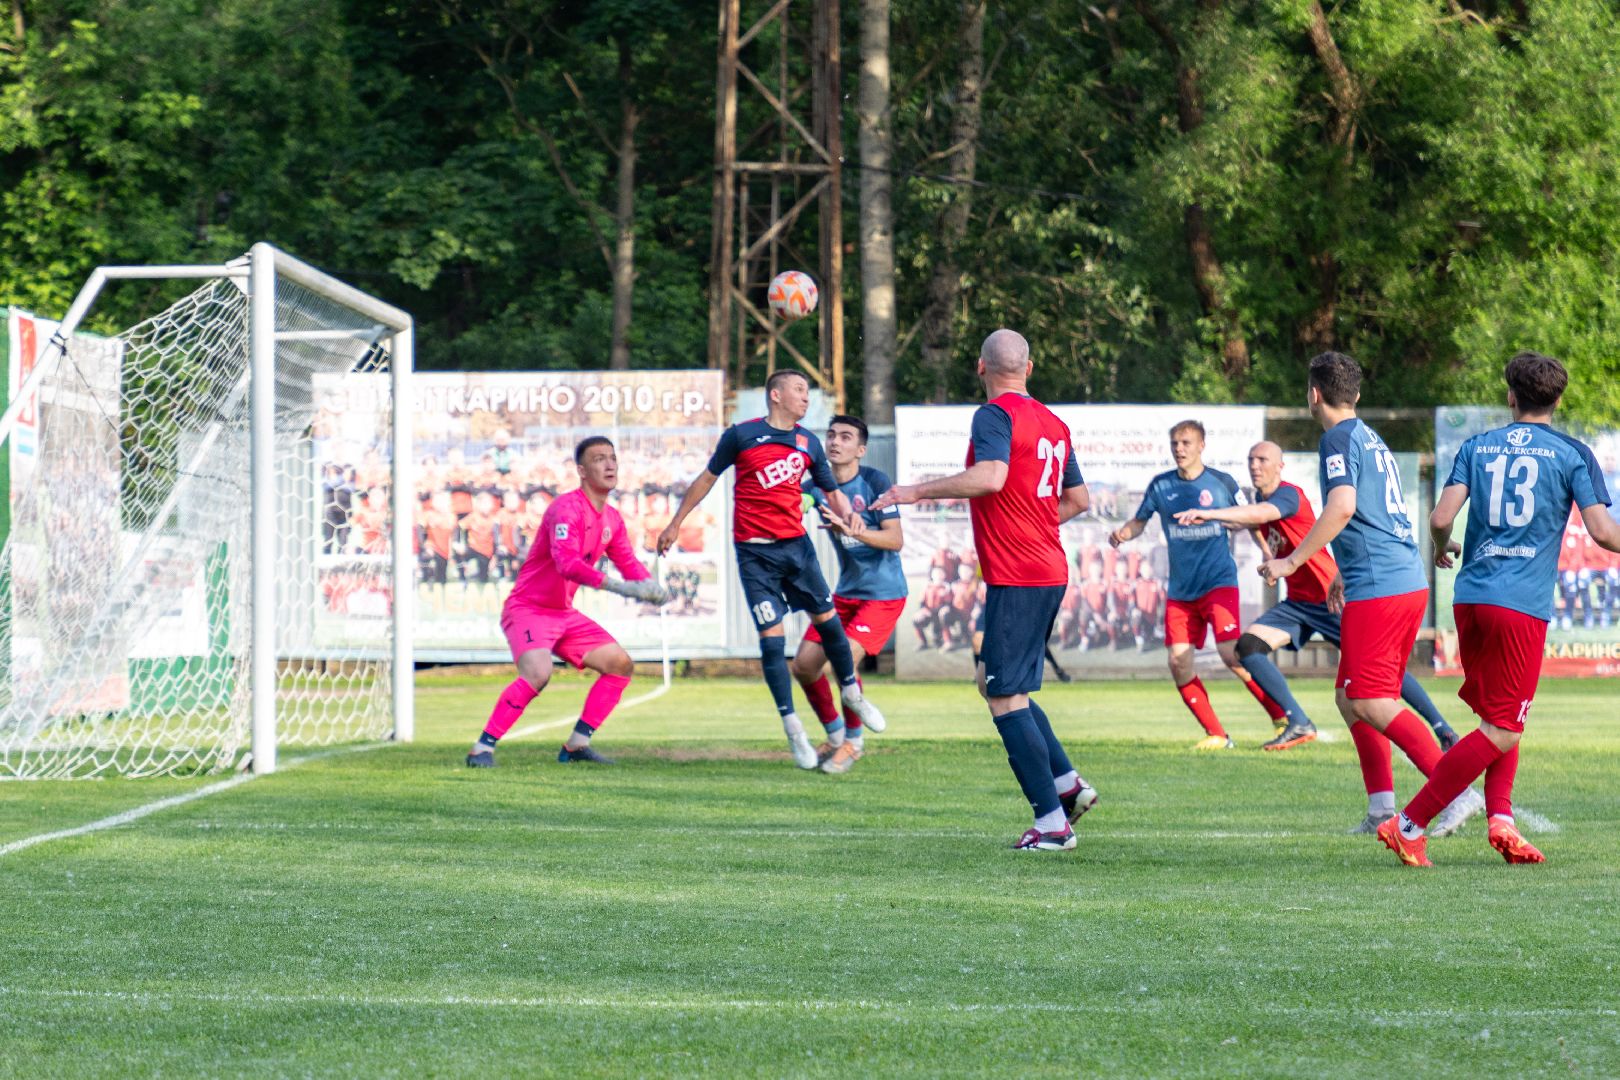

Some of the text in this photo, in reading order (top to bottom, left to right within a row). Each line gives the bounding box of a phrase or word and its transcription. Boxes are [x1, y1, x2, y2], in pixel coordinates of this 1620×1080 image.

[582, 385, 655, 413] 2010
[1476, 446, 1556, 459] БАНИ АЛЕКСЕЕВА
[1037, 437, 1066, 498] 21
[1374, 450, 1408, 514] 20
[1485, 454, 1539, 528] 13
[753, 600, 777, 625] 18
[524, 629, 535, 643] 1
